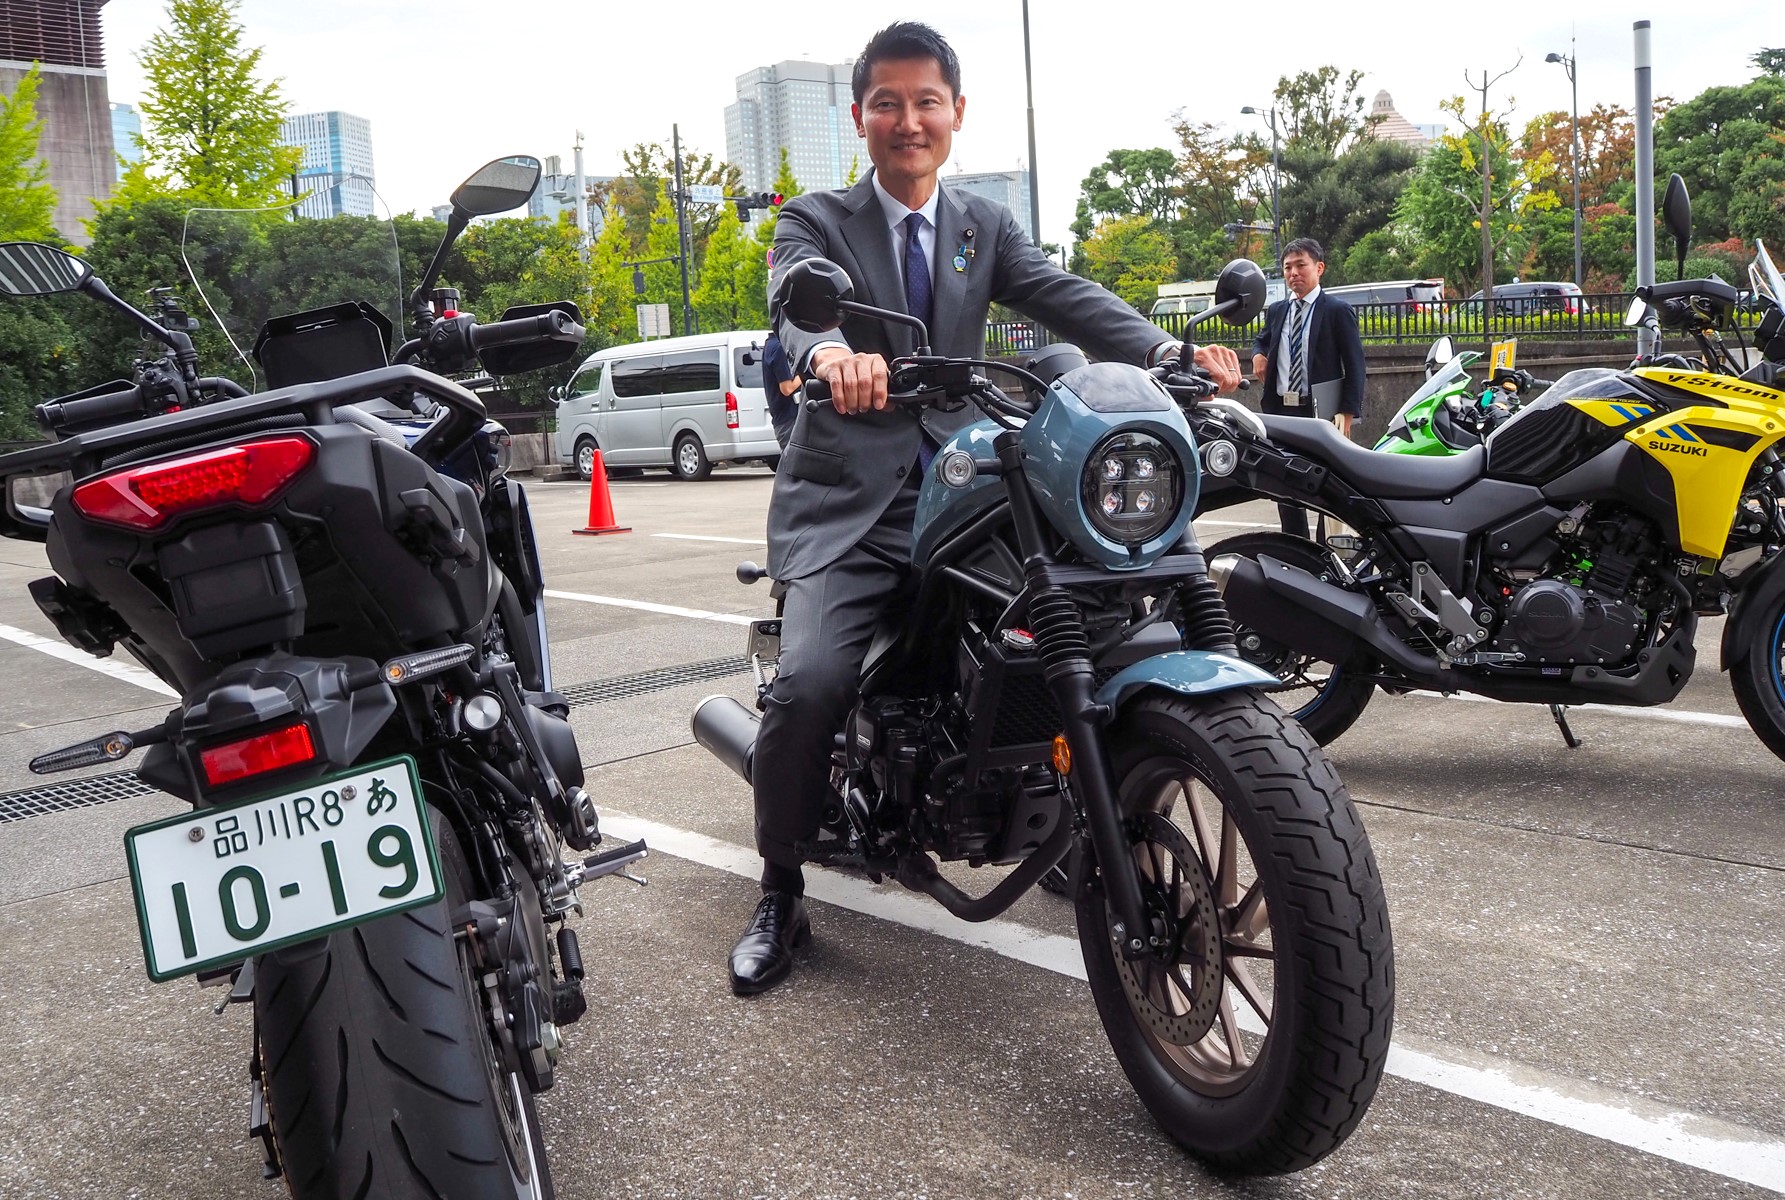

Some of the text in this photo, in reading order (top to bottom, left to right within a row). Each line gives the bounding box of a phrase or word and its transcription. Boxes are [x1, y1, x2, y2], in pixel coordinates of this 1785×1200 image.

[1648, 441, 1708, 457] SUZUKI
[366, 777, 398, 816] あ
[171, 824, 419, 959] 10-19
